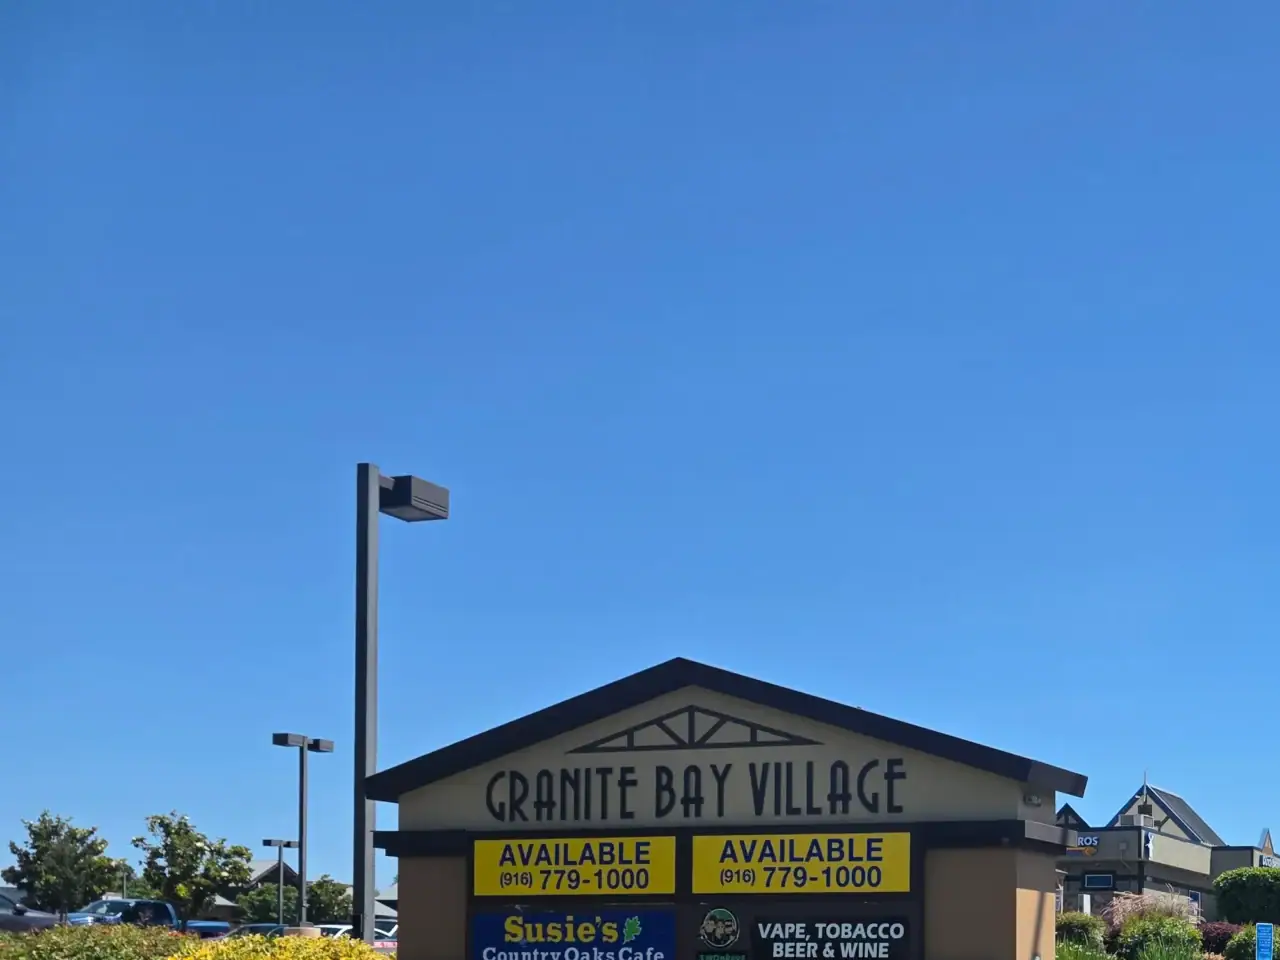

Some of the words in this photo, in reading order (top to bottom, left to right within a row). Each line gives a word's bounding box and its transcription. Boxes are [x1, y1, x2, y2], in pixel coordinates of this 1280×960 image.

[486, 766, 637, 821] GRANITE
[655, 763, 733, 818] BAY
[748, 758, 907, 816] VILLAGE
[719, 838, 883, 863] AVAILABLE
[1077, 836, 1098, 846] ROS
[499, 842, 652, 866] AVAILABLE
[499, 871, 534, 888] (916)
[540, 869, 650, 890] 779-1000
[719, 869, 756, 886] (916)
[763, 866, 882, 888] 779-1000
[504, 915, 619, 943] Susie's
[758, 923, 811, 941] VAPE,
[815, 923, 905, 939] TOBACCO
[772, 943, 818, 958] BEER
[822, 943, 835, 958] &
[840, 943, 890, 958] WINE
